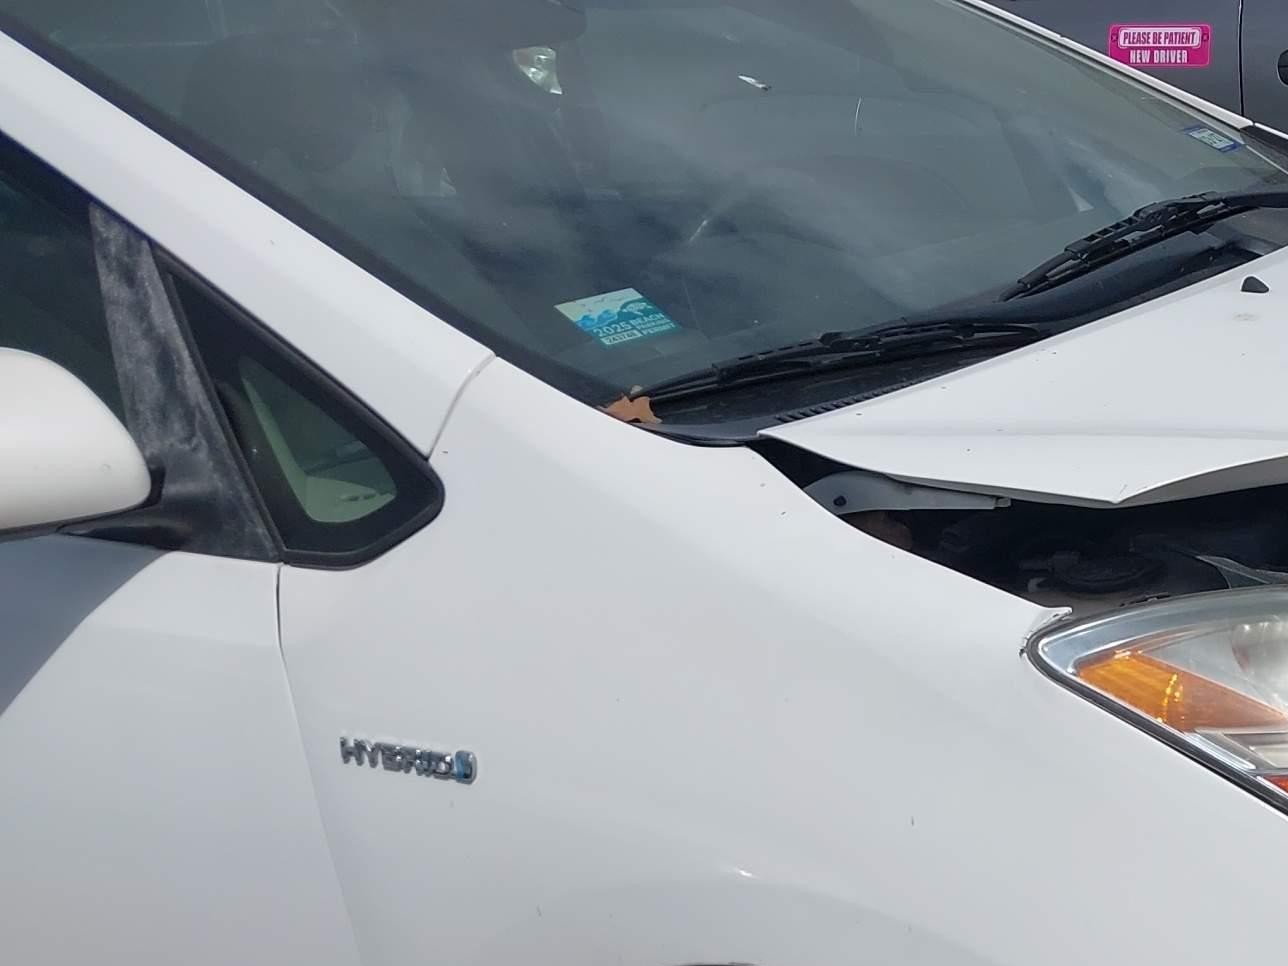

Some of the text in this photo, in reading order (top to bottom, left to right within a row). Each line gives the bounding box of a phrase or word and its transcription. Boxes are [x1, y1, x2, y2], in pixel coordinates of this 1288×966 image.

[1122, 31, 1196, 45] PLEASE BE PATIENT
[1129, 49, 1188, 64] NEW DRIVER
[629, 312, 666, 326] BEACH
[593, 321, 633, 337] 2025
[339, 736, 454, 781] HYBRID
